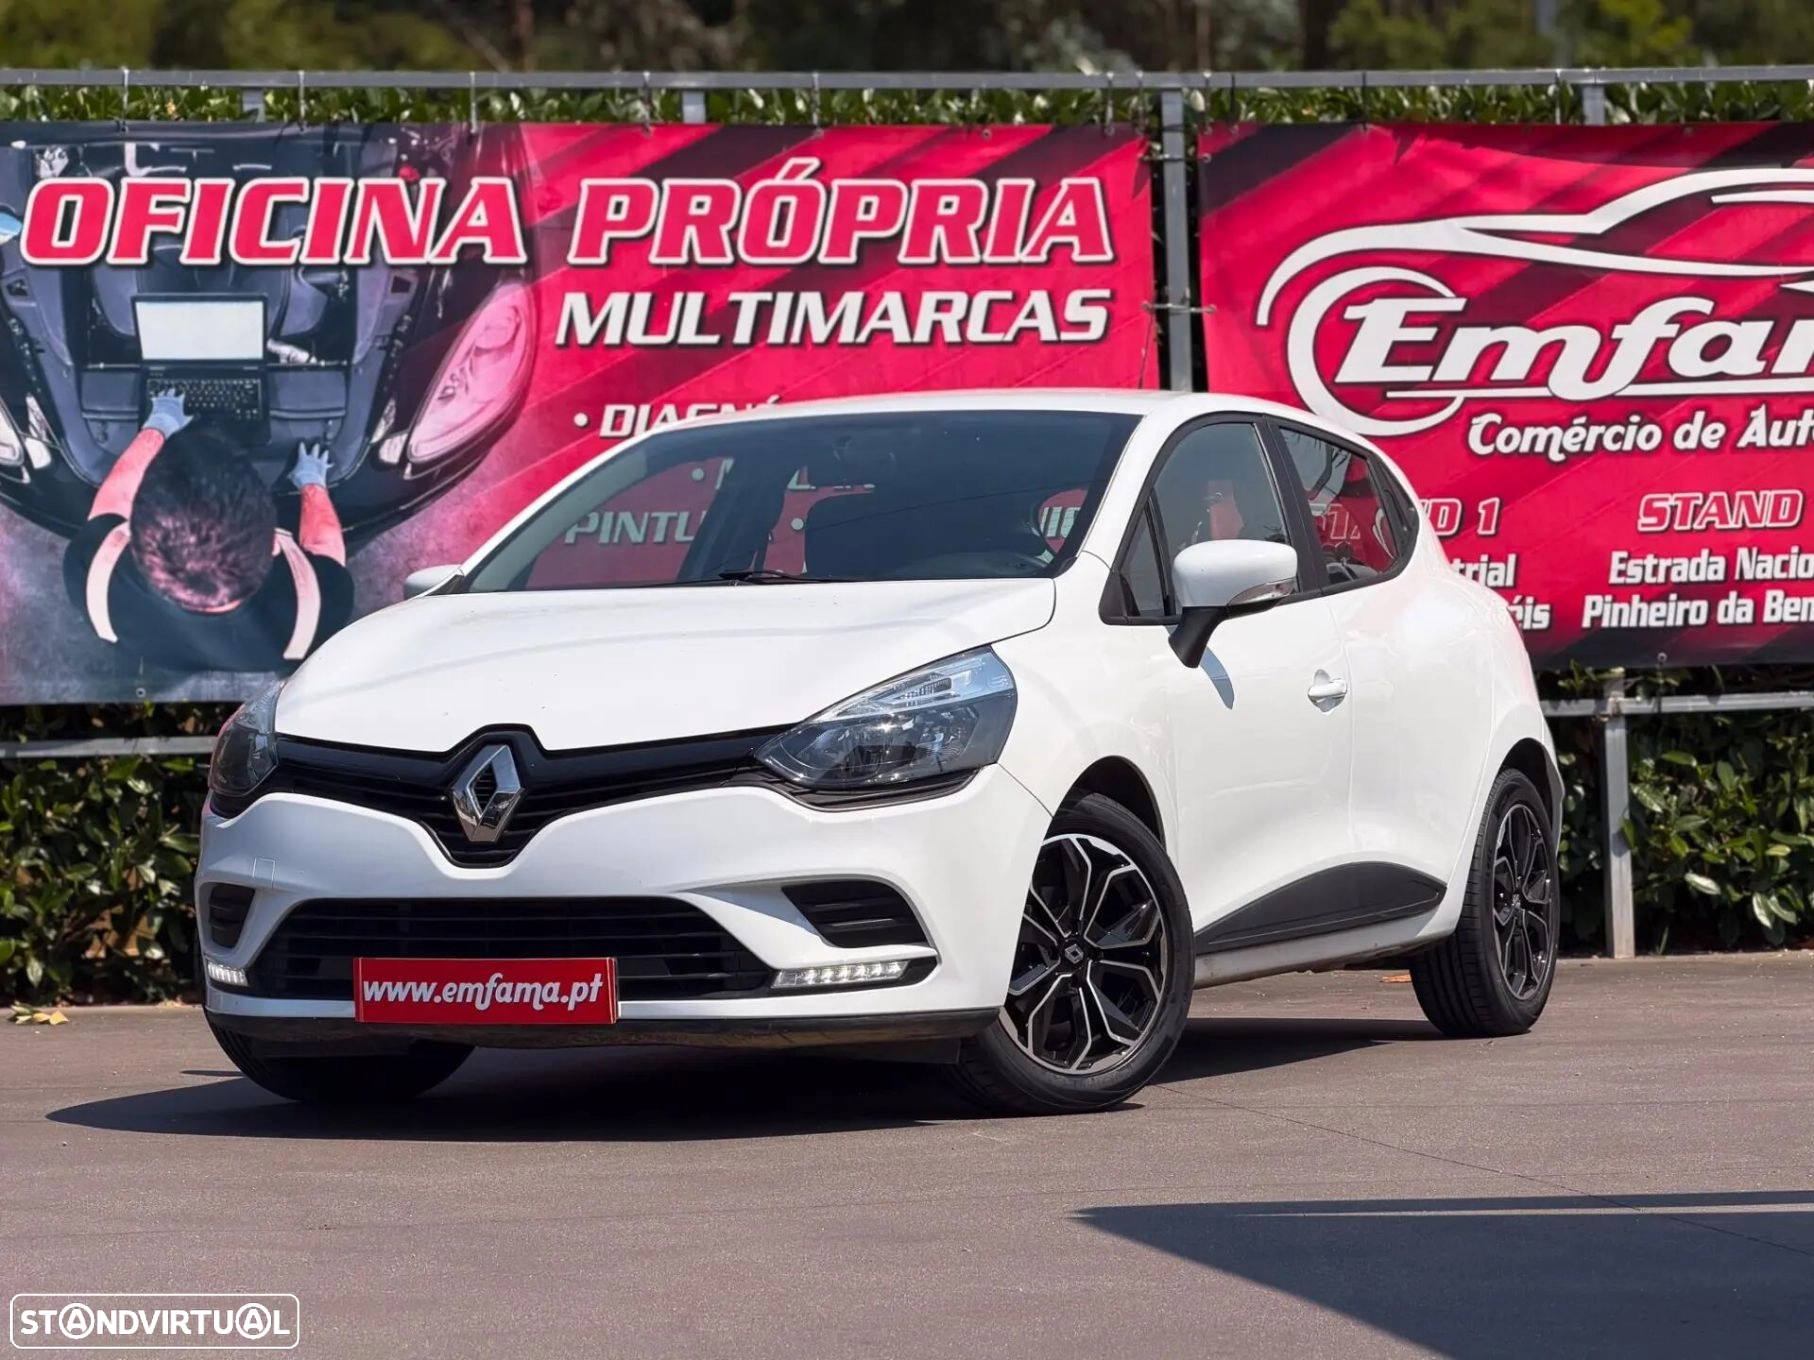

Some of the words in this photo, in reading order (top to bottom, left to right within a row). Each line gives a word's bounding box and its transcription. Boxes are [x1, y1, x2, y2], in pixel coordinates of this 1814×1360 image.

[20, 177, 528, 265] OFICINA
[566, 157, 1114, 265] PRÓPRIA
[555, 289, 1111, 345] MULTIMARCAS
[1468, 412, 1663, 462] Comércio
[1673, 410, 1727, 450] de
[1736, 403, 1814, 448] Aut
[1477, 497, 1500, 535] 1
[1637, 489, 1803, 532] STAND
[1608, 548, 1726, 584] Estrada
[1581, 593, 1708, 628] Pinheiro
[1717, 591, 1754, 624] da
[363, 972, 603, 1011] www.emfama.pt
